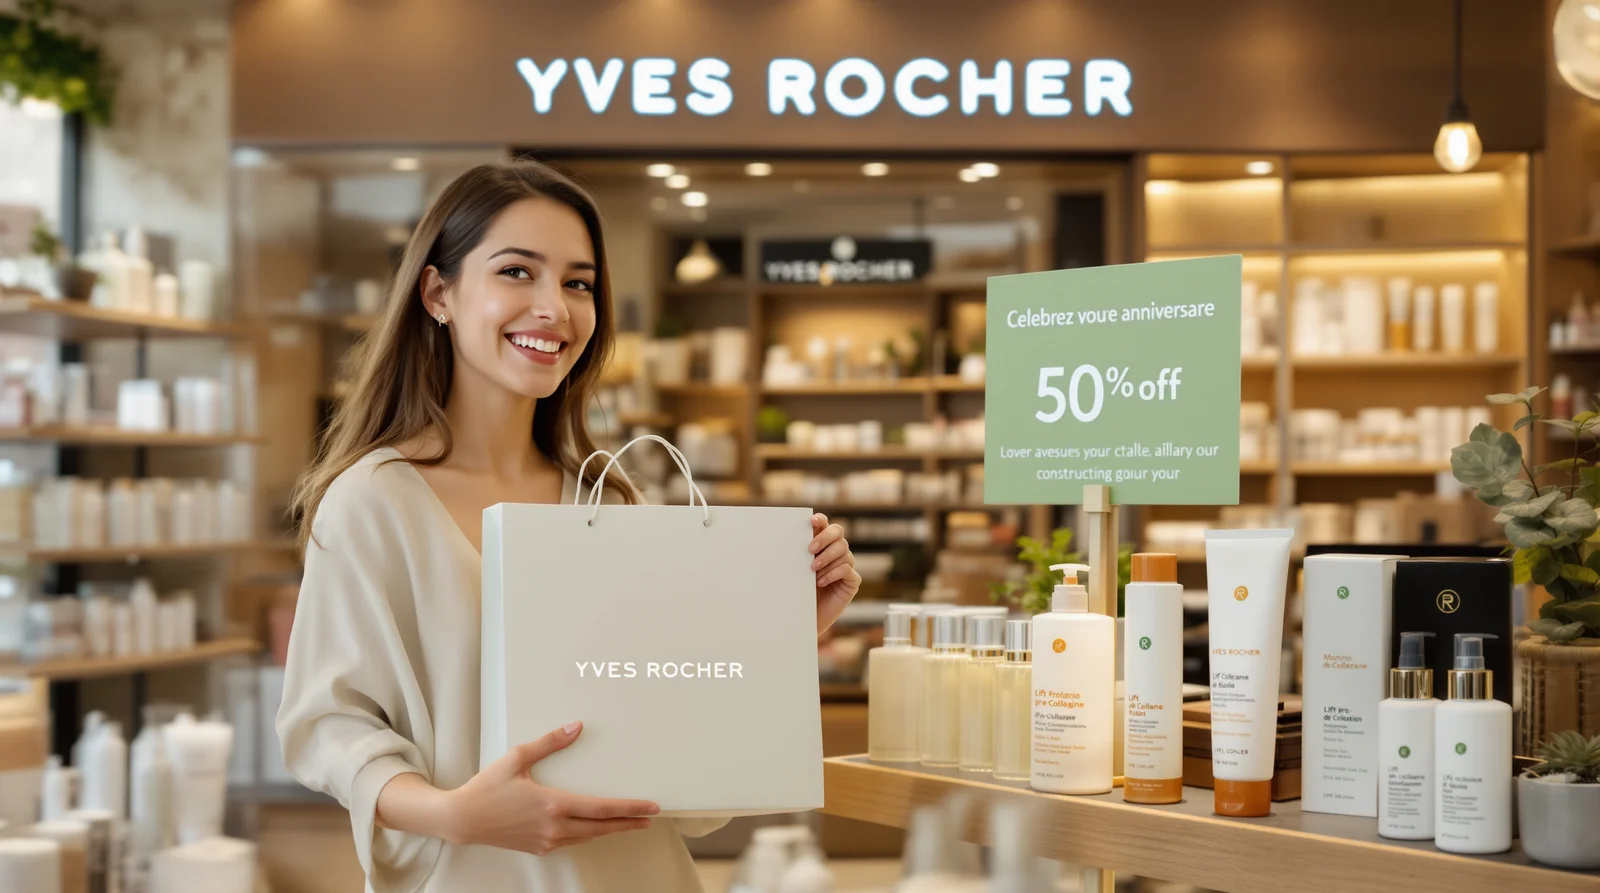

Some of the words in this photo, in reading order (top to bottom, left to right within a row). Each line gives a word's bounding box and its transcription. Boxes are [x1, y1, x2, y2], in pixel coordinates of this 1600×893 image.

[516, 57, 733, 116] YVES
[767, 57, 1133, 117] ROCHER
[1007, 308, 1074, 328] Celebrez
[1121, 301, 1215, 321] anniversare
[1139, 367, 1183, 400] off
[1000, 446, 1031, 459] Lover
[1083, 447, 1111, 461] your
[1196, 445, 1219, 457] our
[1037, 467, 1112, 482] constructing
[1151, 468, 1180, 482] your
[575, 661, 637, 678] YVES
[647, 662, 743, 678] ROCHER
